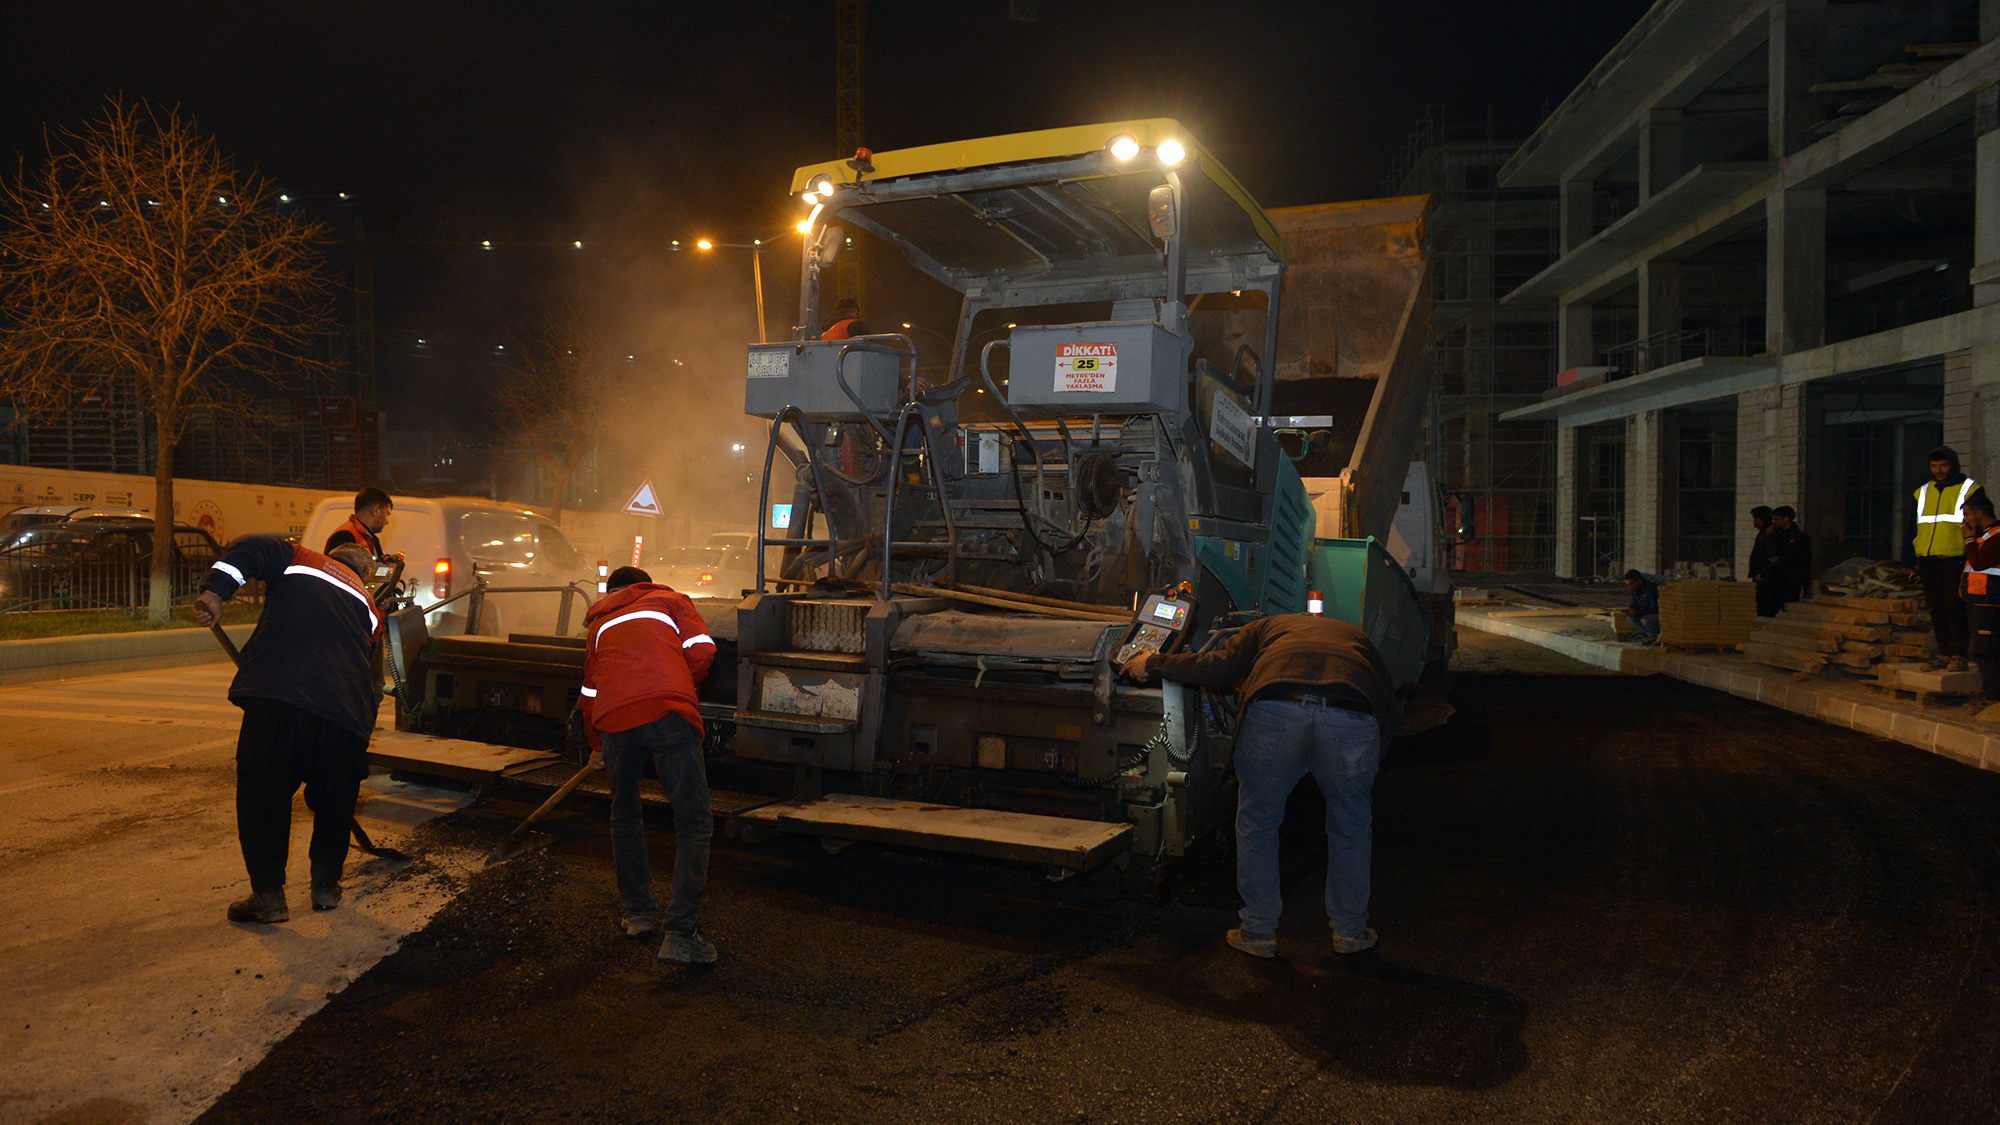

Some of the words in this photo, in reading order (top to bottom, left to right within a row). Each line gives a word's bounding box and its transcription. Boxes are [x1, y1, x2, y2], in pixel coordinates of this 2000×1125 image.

[1063, 345, 1111, 356] DİKKAT!
[768, 354, 787, 364] KBB
[1077, 360, 1095, 369] 25
